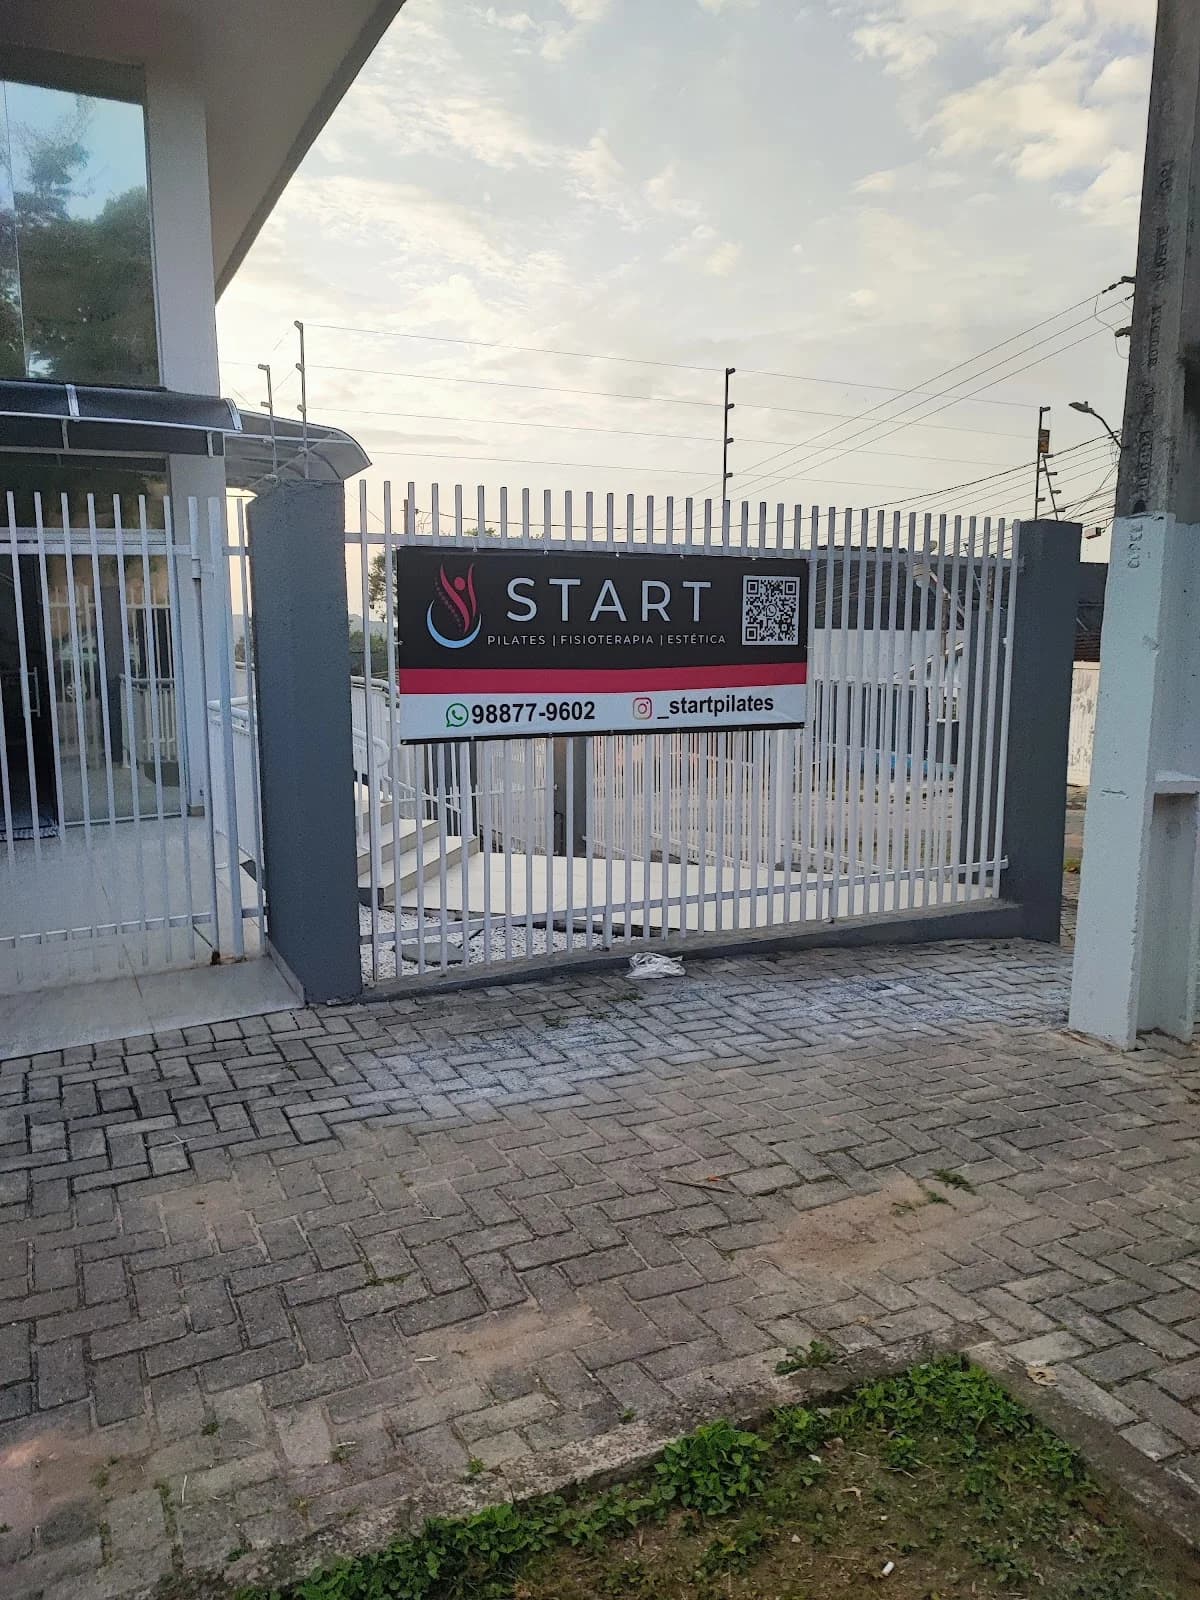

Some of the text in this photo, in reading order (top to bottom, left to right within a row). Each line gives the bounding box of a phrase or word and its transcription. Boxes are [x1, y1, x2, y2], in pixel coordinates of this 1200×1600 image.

[506, 577, 712, 622] START
[487, 632, 726, 645] PILATES FISIOTERAPIA ESTÉTICA
[472, 700, 596, 724] 98877-9602
[657, 694, 774, 719] _startpilates
